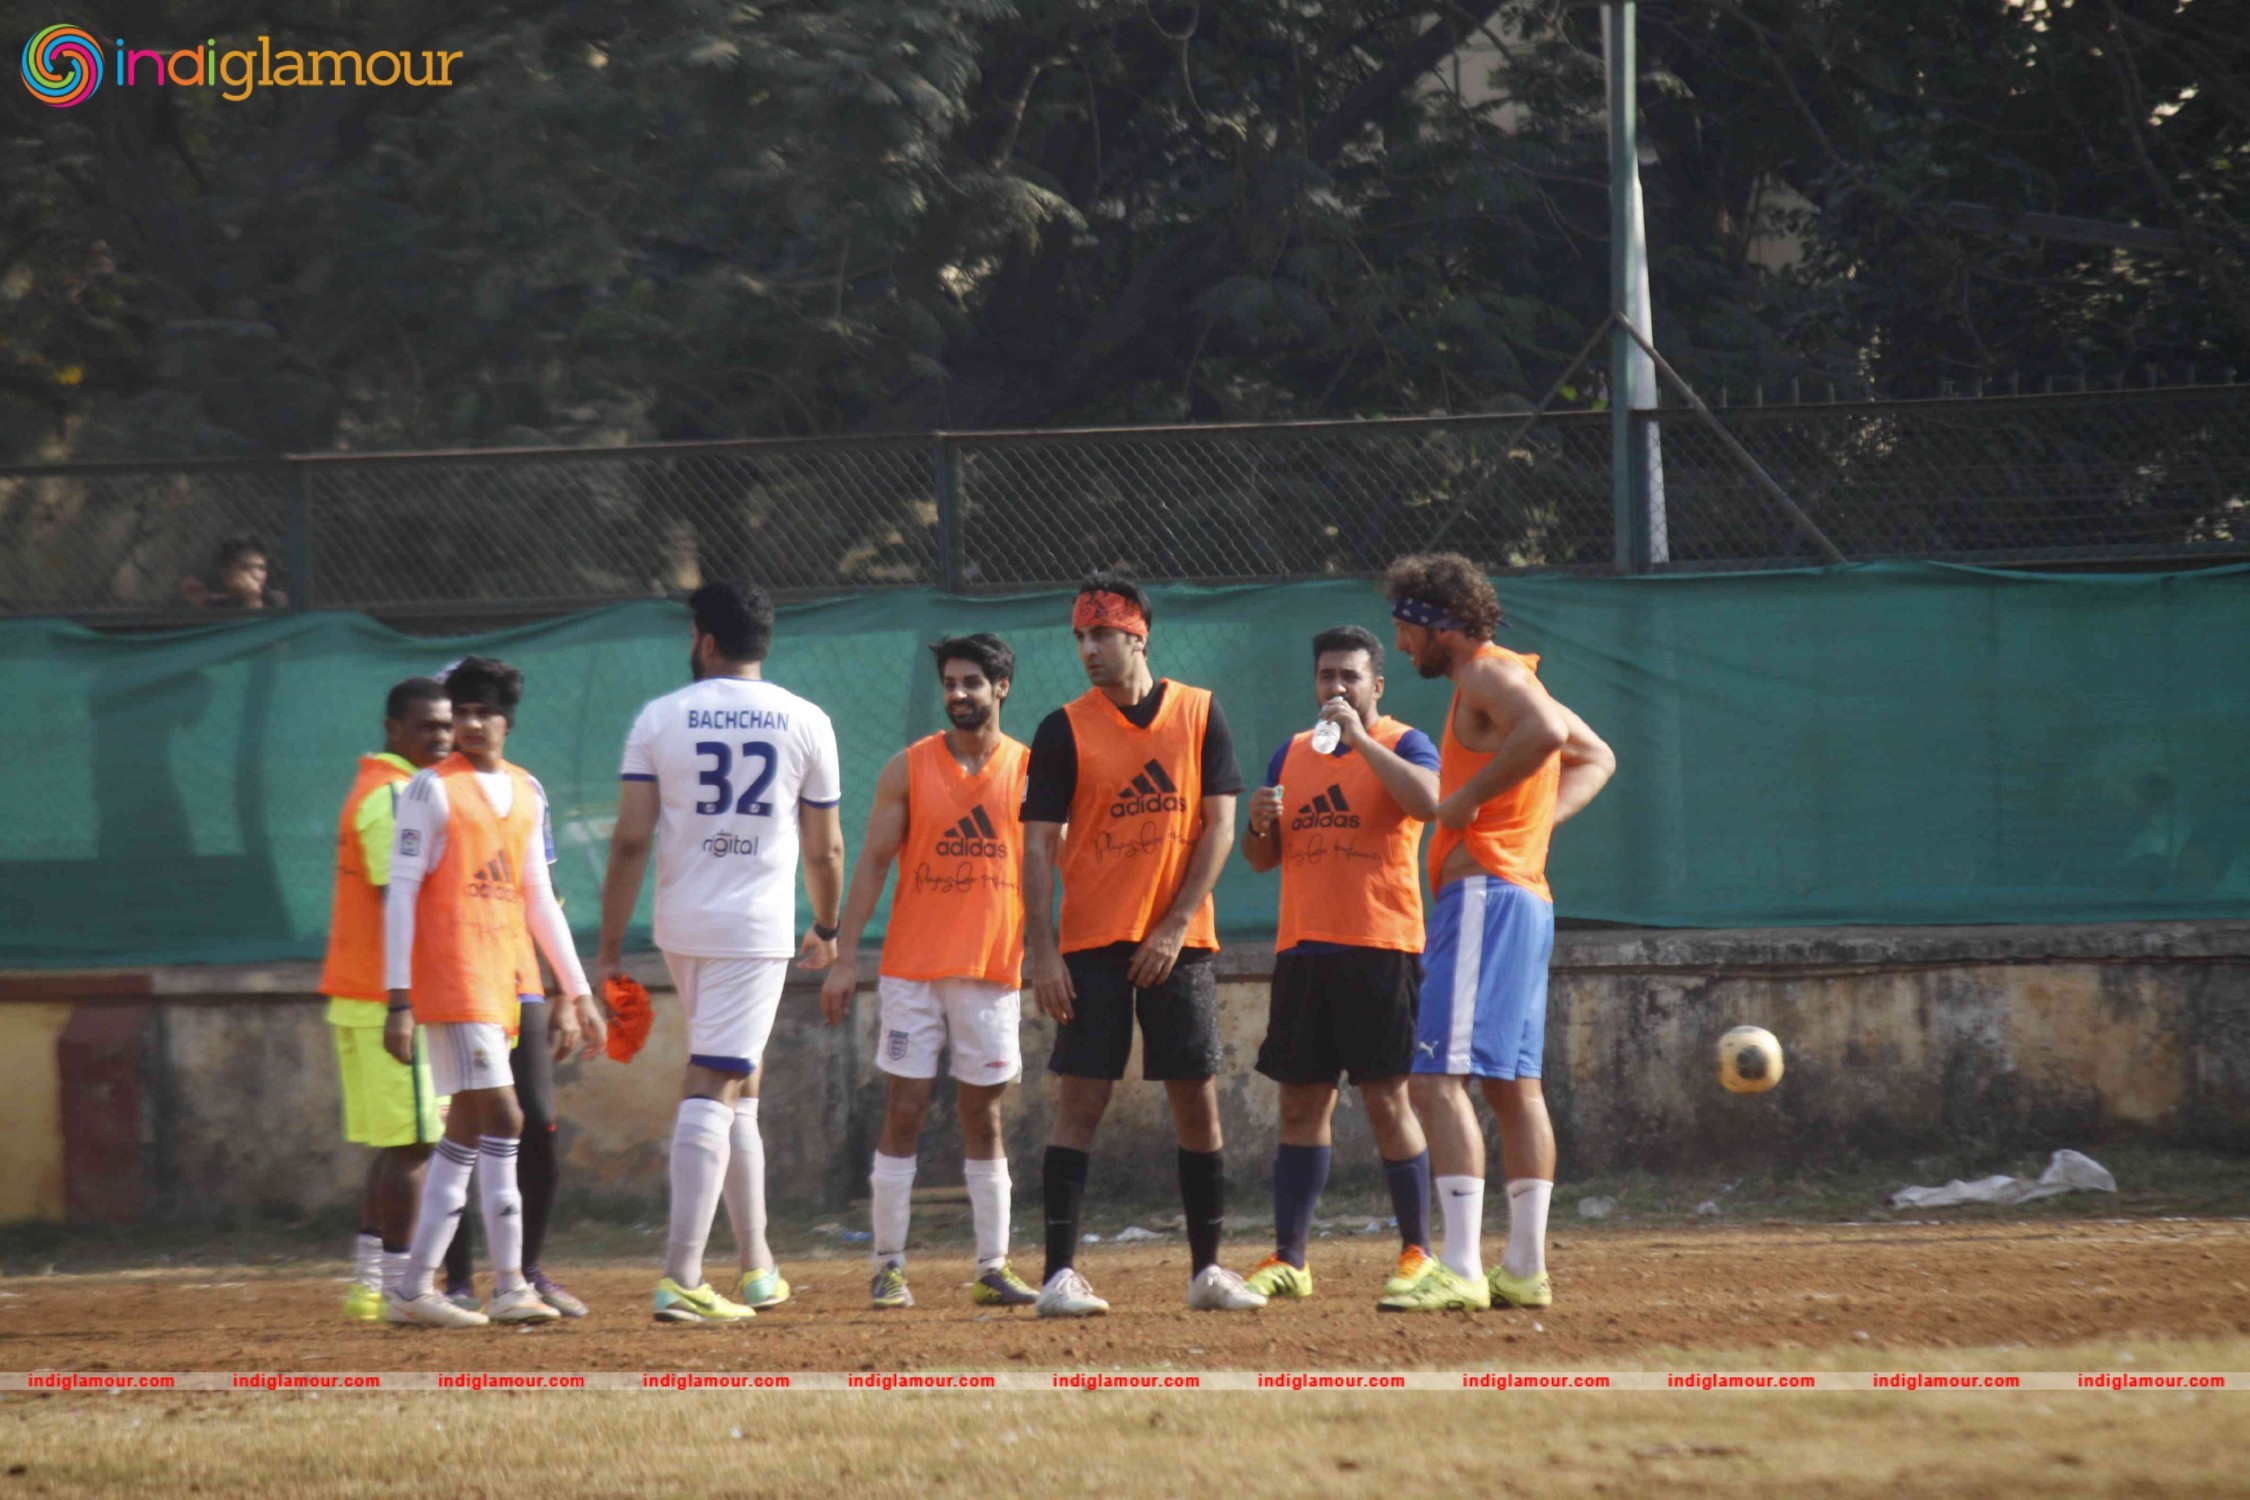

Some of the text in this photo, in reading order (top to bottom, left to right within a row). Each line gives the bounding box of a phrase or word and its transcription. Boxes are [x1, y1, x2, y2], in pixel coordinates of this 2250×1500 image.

[687, 709, 790, 732] BACHCHAN
[695, 741, 778, 817] 32
[1110, 792, 1187, 819] adidas
[1292, 811, 1361, 831] adidas
[936, 837, 1008, 858] adidas
